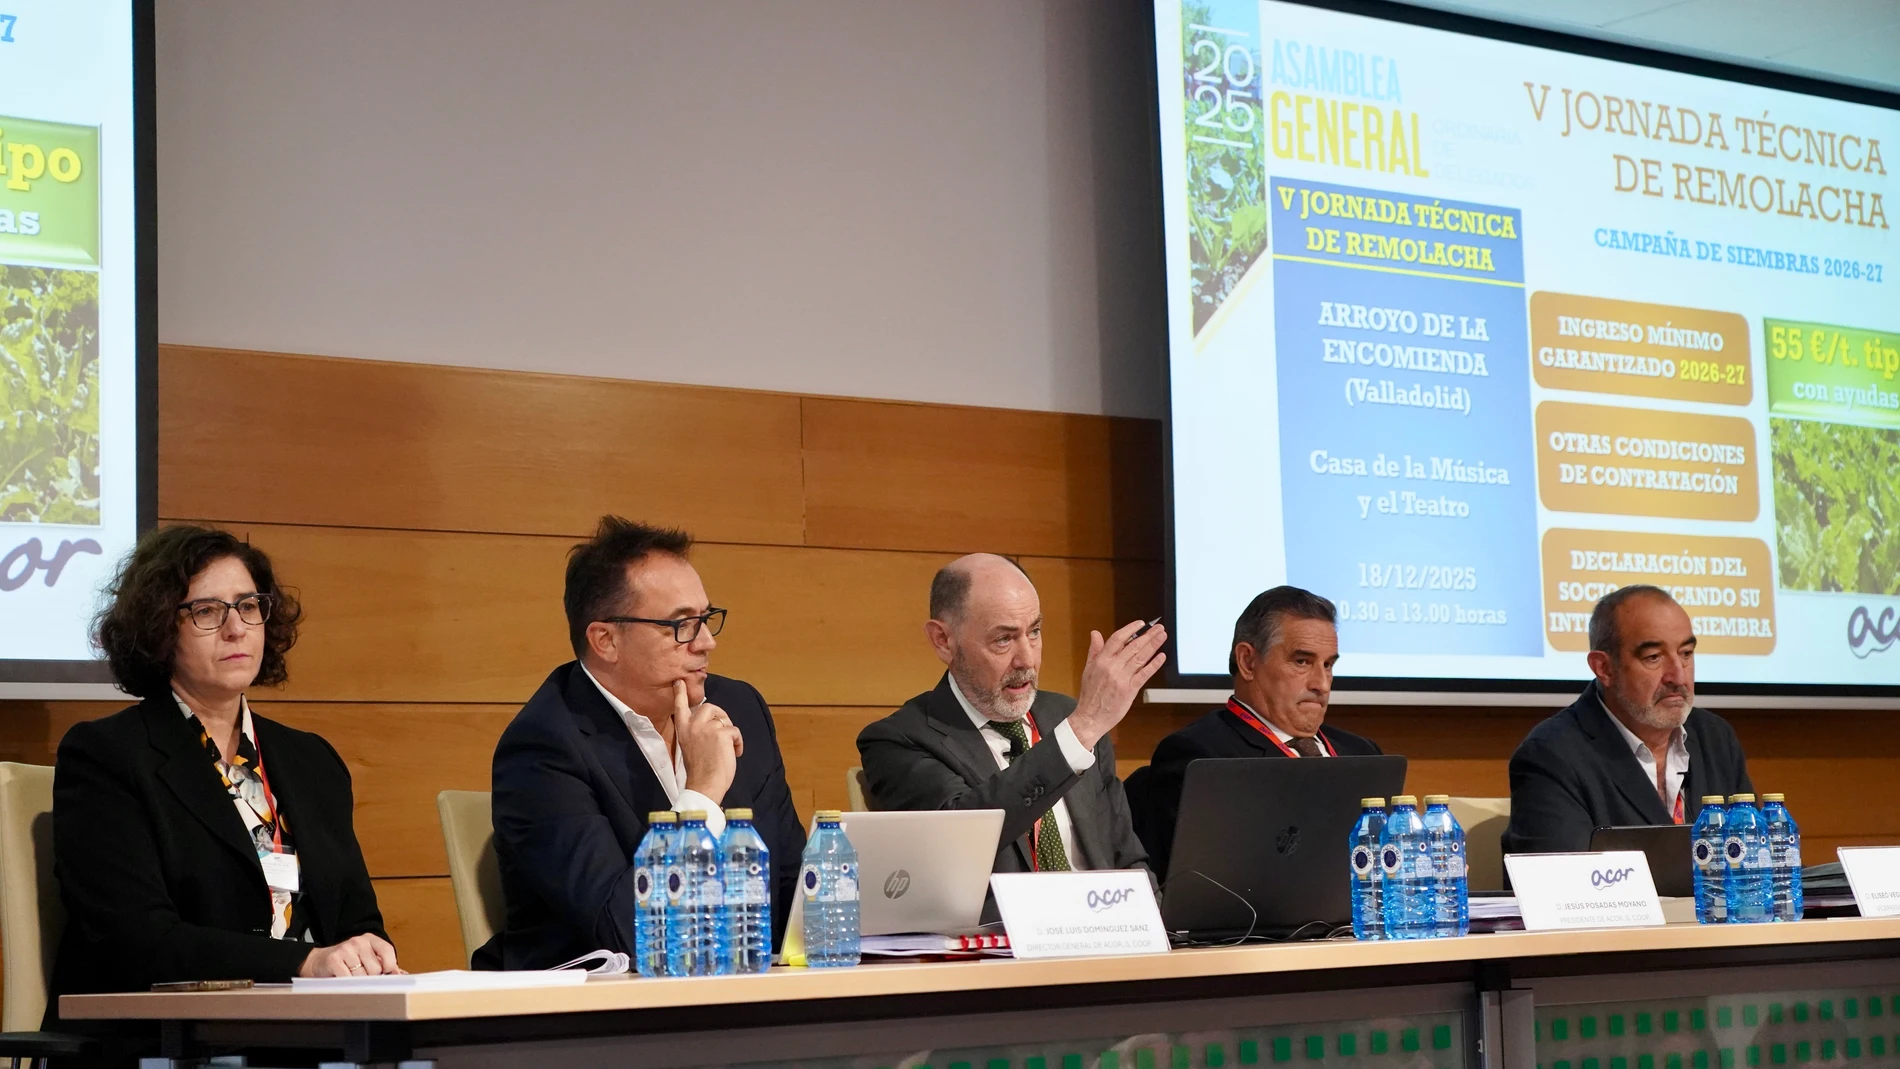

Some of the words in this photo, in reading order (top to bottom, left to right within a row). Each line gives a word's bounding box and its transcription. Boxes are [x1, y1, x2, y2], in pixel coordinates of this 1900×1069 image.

[1193, 39, 1255, 88] 20
[1271, 38, 1402, 103] ASAMBLEA
[1194, 86, 1255, 133] 25
[1270, 90, 1429, 178] GENERAL
[1523, 81, 1551, 121] V
[1561, 87, 1729, 151] JORNADA
[1735, 110, 1887, 176] TÉCNICA
[0, 127, 82, 191] ipo
[1613, 153, 1664, 197] DE
[1672, 163, 1890, 230] REMOLACHA
[1278, 185, 1297, 210] V
[1300, 189, 1412, 226] JORNADA
[1414, 201, 1518, 240] TÉCNICA
[1306, 226, 1341, 254] DE
[1346, 231, 1496, 272] REMOLACHA
[1594, 228, 1692, 259] CAMPAÑA
[1696, 241, 1723, 263] DE
[1727, 249, 1820, 275] SIEMBRAS
[1824, 258, 1883, 284] 2026-27
[1318, 301, 1418, 334] ARROYO
[1422, 312, 1456, 340] DE
[1460, 316, 1490, 342] LA
[1558, 315, 1643, 343] INGRESO
[1648, 321, 1724, 352] MÍNIMO
[1322, 338, 1489, 377] ENCOMIENDA
[1539, 347, 1676, 379] GARANTIZADO
[1679, 359, 1745, 385] 2026-27
[1771, 326, 1803, 361] 55
[1863, 338, 1900, 379] tip
[1345, 377, 1472, 416] (Valladolid)
[1793, 380, 1829, 401] con
[1834, 383, 1900, 410] ayudas
[1549, 431, 1612, 455] OTRAS
[1615, 437, 1745, 465] CONDICIONES
[1309, 450, 1368, 476] Casa
[1373, 454, 1400, 477] de
[1404, 455, 1426, 480] la
[1430, 457, 1511, 486] Música
[1559, 463, 1588, 485] DE
[1591, 466, 1739, 495] CONTRATACIÓN
[1358, 495, 1372, 519] y
[1377, 490, 1398, 514] el
[1402, 491, 1471, 518] Teatro
[0, 537, 103, 592] or
[1358, 562, 1477, 592] 18/12/2025
[1570, 549, 1707, 576] DECLARACIÓN
[1711, 557, 1748, 577] DEL
[1332, 600, 1380, 622] 0.30
[1384, 606, 1397, 623] a
[1401, 601, 1450, 624] 13.00
[1454, 604, 1508, 626] horas
[1663, 585, 1736, 607] CANDO
[1741, 588, 1760, 608] SU
[1692, 616, 1773, 638] SIEMBRA
[1847, 606, 1900, 650] ac
[884, 869, 911, 899] hp
[1591, 867, 1635, 888] acor
[1087, 887, 1136, 910] acor
[1585, 901, 1618, 910] POSADAS
[1618, 900, 1647, 909] MOYANO
[1065, 925, 1083, 935] LUIS
[1083, 924, 1129, 935] DOMÍNGUEZ
[1129, 924, 1149, 933] SANZ
[1559, 916, 1597, 925] PRESIDENTE
[1598, 915, 1606, 923] DE
[1027, 943, 1062, 953] DIRECTOR
[1062, 942, 1092, 951] GENERAL
[1093, 941, 1103, 949] DE
